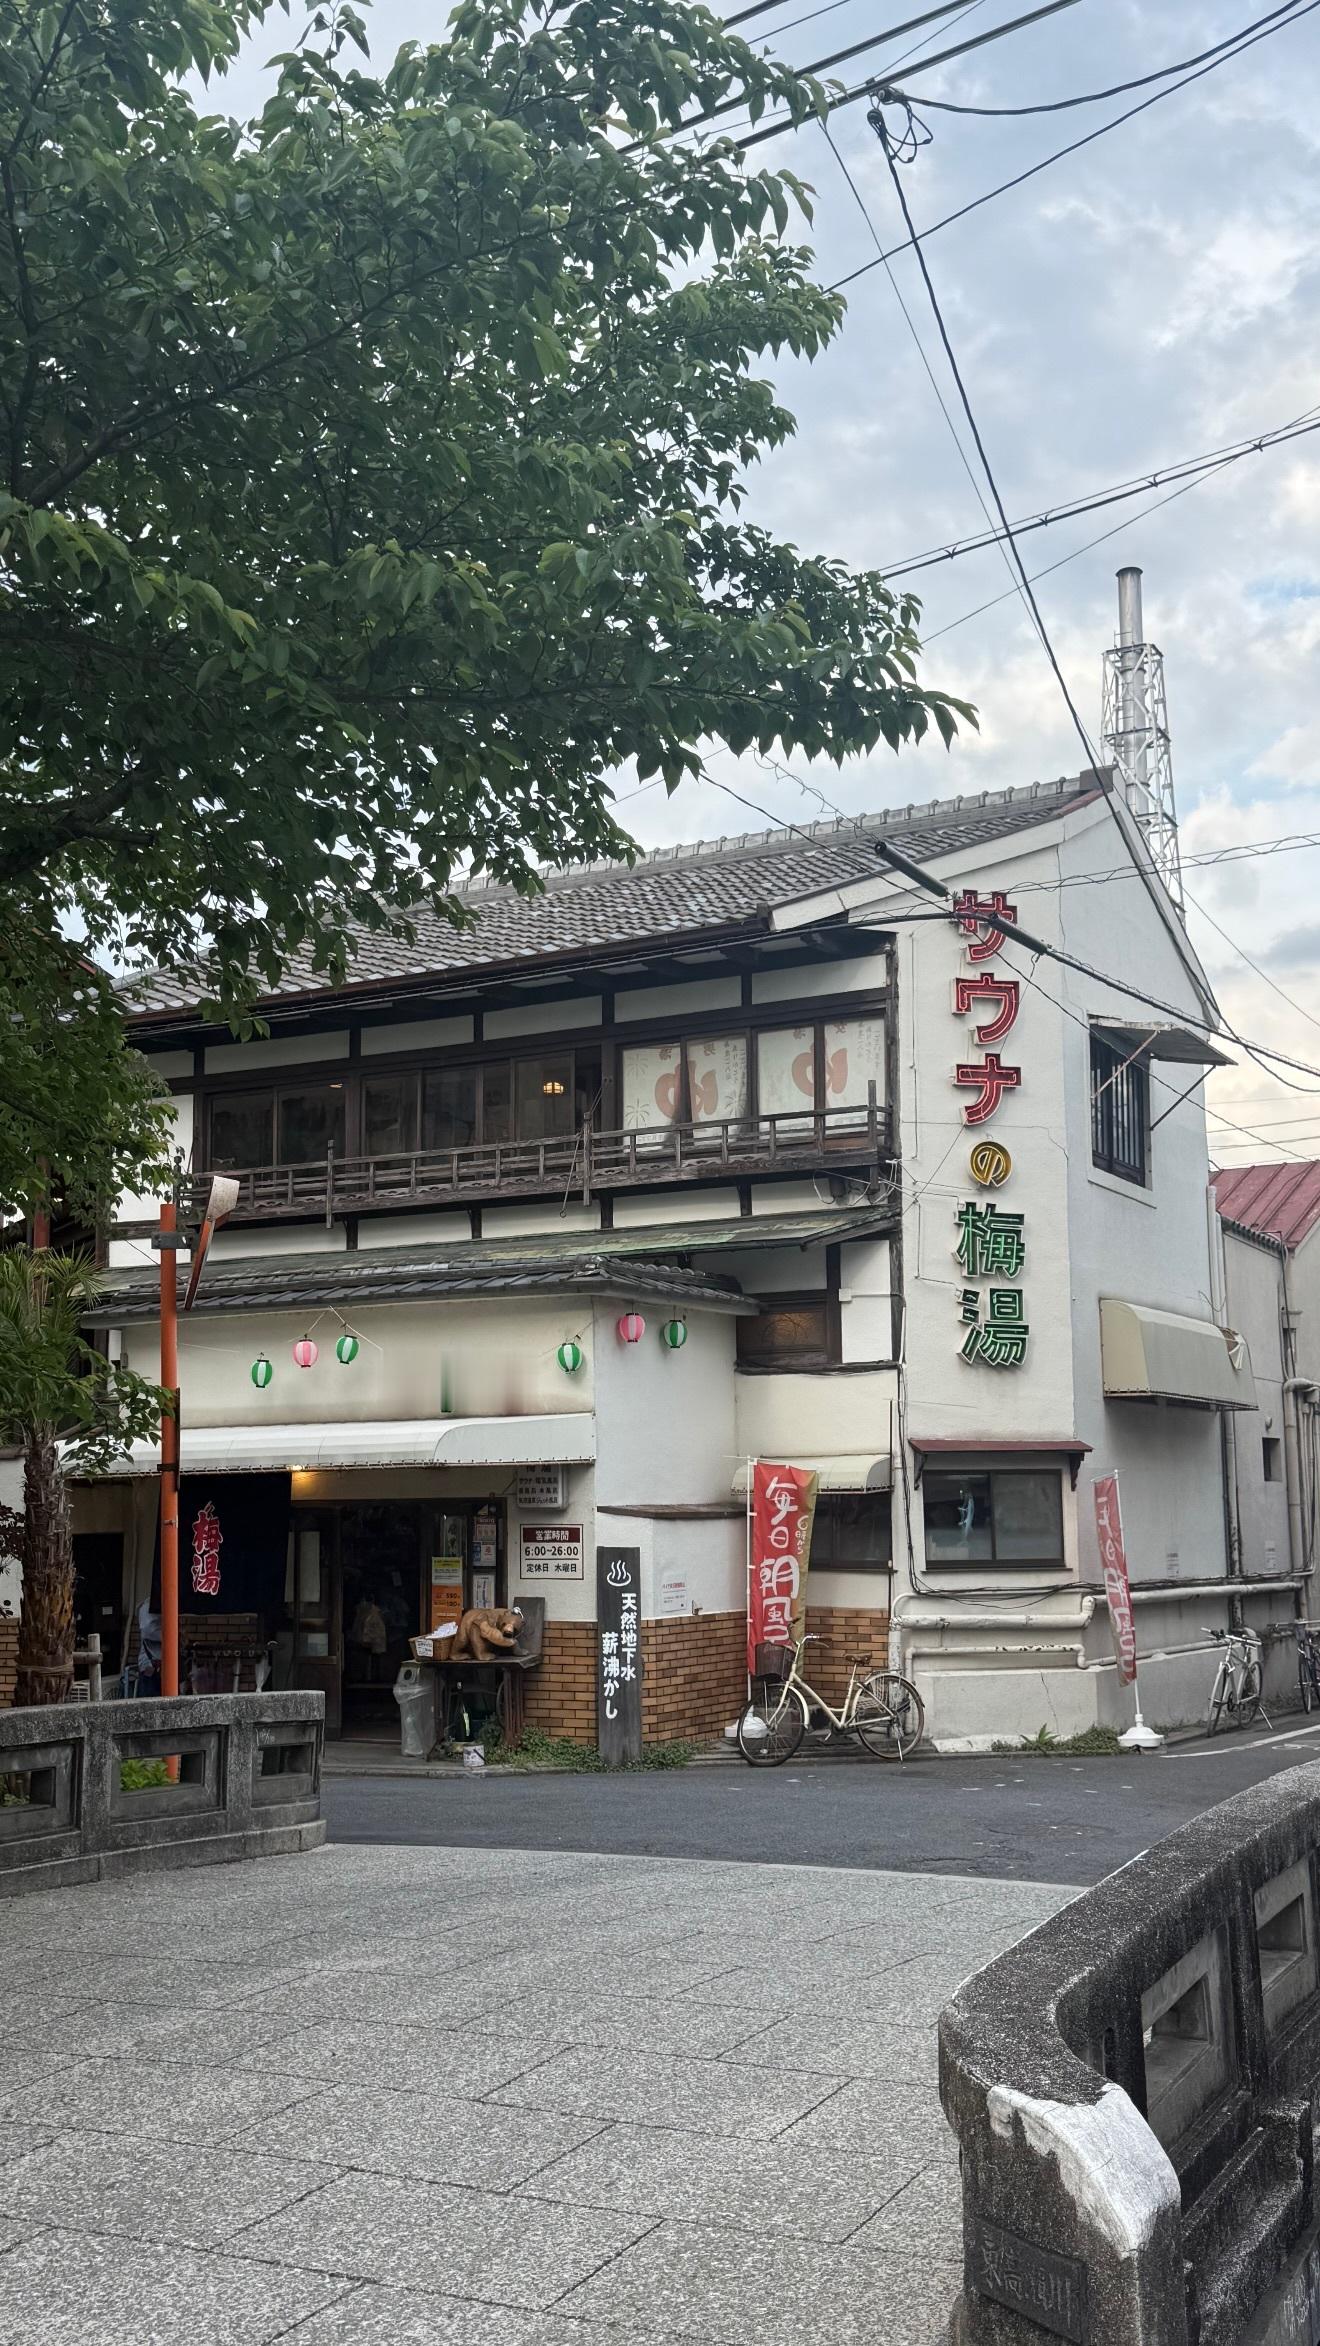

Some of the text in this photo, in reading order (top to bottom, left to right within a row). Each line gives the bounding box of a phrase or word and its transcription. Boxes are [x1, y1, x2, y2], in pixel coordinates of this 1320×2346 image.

[954, 889, 1030, 1368] サウナの梅湯
[191, 1501, 223, 1595] 梅湯
[526, 1563, 577, 1573] 定休日 木曜日
[535, 1530, 569, 1541] 営業時間
[601, 1631, 620, 1719] 薪沸かし
[620, 1592, 638, 1681] 天然地下水
